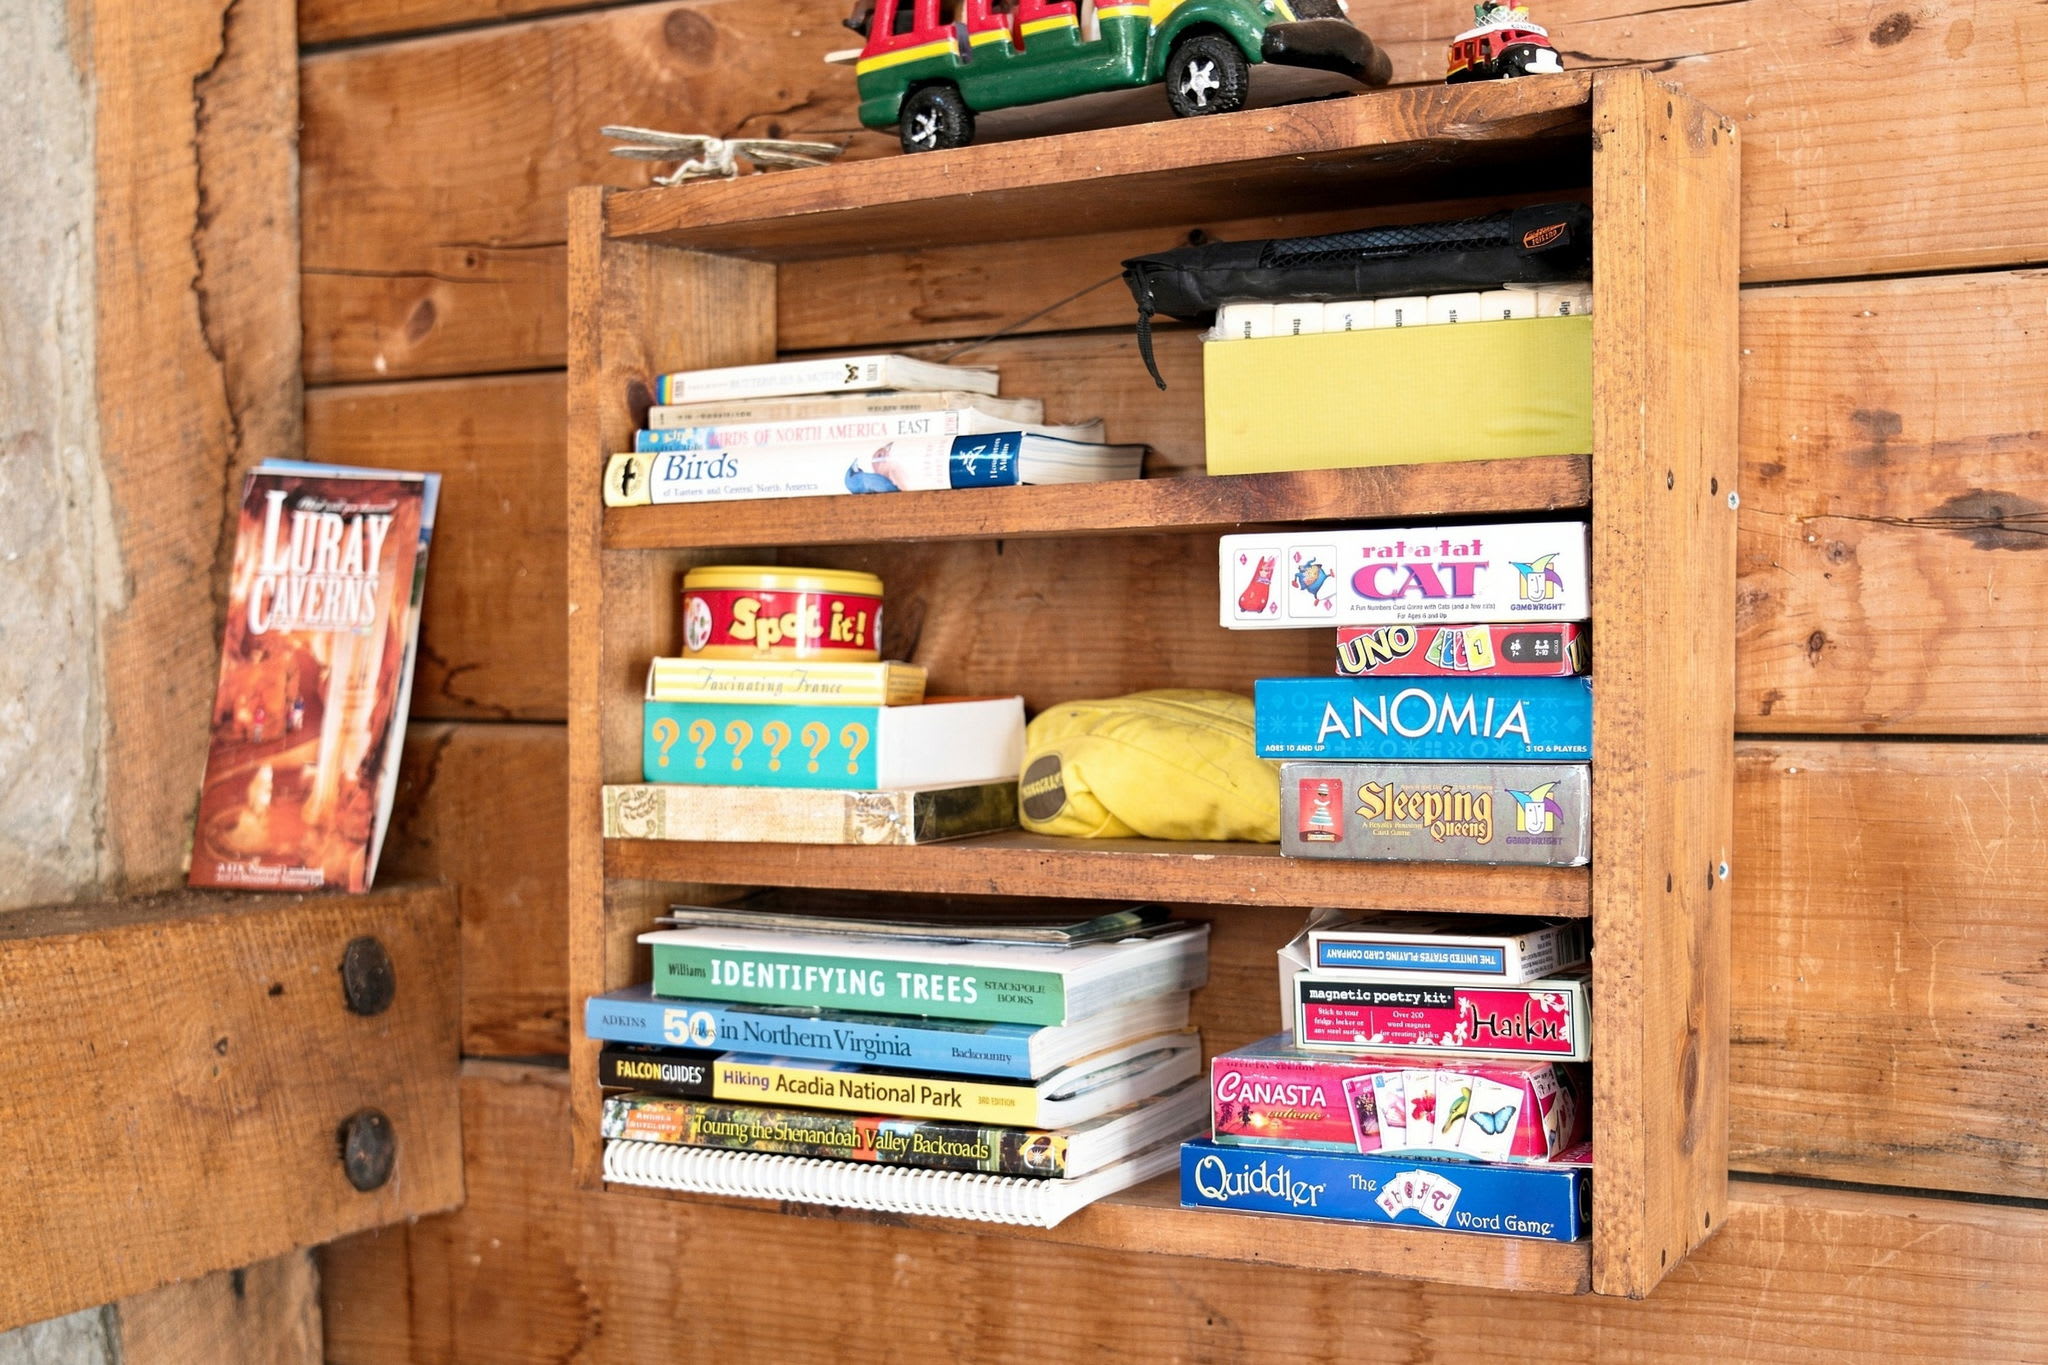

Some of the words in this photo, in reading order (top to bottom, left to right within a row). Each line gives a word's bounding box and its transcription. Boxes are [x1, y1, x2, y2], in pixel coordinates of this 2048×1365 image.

[711, 429, 750, 447] BIRDS
[755, 427, 771, 445] OF
[775, 424, 828, 444] NORTH
[829, 422, 888, 441] AMERICA
[898, 418, 930, 435] EAST
[663, 453, 738, 481] Birds
[259, 490, 395, 576] LURAY
[1350, 560, 1489, 601] CAT
[248, 574, 379, 635] CAVERNS
[728, 597, 824, 651] Spot
[829, 600, 867, 647] it!
[1337, 624, 1416, 674] UNO
[1474, 638, 1483, 655] 1
[695, 667, 783, 696] Fascinating
[790, 669, 843, 693] France
[1317, 688, 1531, 744] ANOMIA
[1265, 744, 1284, 752] AGES
[1286, 744, 1295, 752] 10
[1296, 744, 1313, 752] AND
[1314, 744, 1325, 752] UP
[1553, 745, 1587, 753] PLAYERS
[1355, 780, 1493, 845] Sleeping
[1430, 819, 1487, 843] Queens
[1326, 948, 1363, 960] COMPANY
[1363, 950, 1384, 960] CARD
[1385, 951, 1419, 963] PLAYING
[1420, 952, 1449, 964] STATES
[1451, 954, 1477, 964] UNITED
[1479, 955, 1496, 965] THE
[669, 963, 706, 978] Williams
[711, 959, 886, 997] IDENTIFYING
[897, 972, 977, 1003] TREES
[984, 981, 1047, 994] STACKPOLE
[1309, 989, 1371, 1001] magnetic
[1373, 992, 1421, 1005] poetry
[1423, 992, 1447, 1004] kit
[998, 994, 1033, 1005] BOOKS
[602, 1015, 647, 1029] ADKINS
[1318, 1007, 1334, 1015] Stick
[1392, 1010, 1409, 1019] Over
[1471, 1000, 1557, 1043] Haiku
[664, 1008, 716, 1047] 50
[721, 1019, 738, 1040] in
[742, 1021, 832, 1048] Northern
[834, 1030, 912, 1060] Virginia
[1387, 1020, 1403, 1028] word
[952, 1047, 1012, 1064] Backcountry
[616, 1059, 703, 1084] FALCONGUIDES
[724, 1070, 769, 1091] Hiking
[776, 1075, 834, 1096] Acadia
[840, 1080, 915, 1103] National
[921, 1085, 962, 1108] Park
[1217, 1071, 1327, 1108] CANASTA
[978, 1095, 990, 1105] 3RD
[991, 1096, 1015, 1107] EDITION
[695, 1114, 748, 1142] Touring
[750, 1119, 773, 1139] the
[775, 1121, 861, 1148] Shenandoah
[865, 1129, 910, 1154] Valley
[913, 1134, 990, 1159] Backroads
[1195, 1154, 1324, 1208] Quiddler
[1348, 1172, 1377, 1192] The
[1455, 1210, 1500, 1231] Word
[1504, 1214, 1551, 1235] Game
